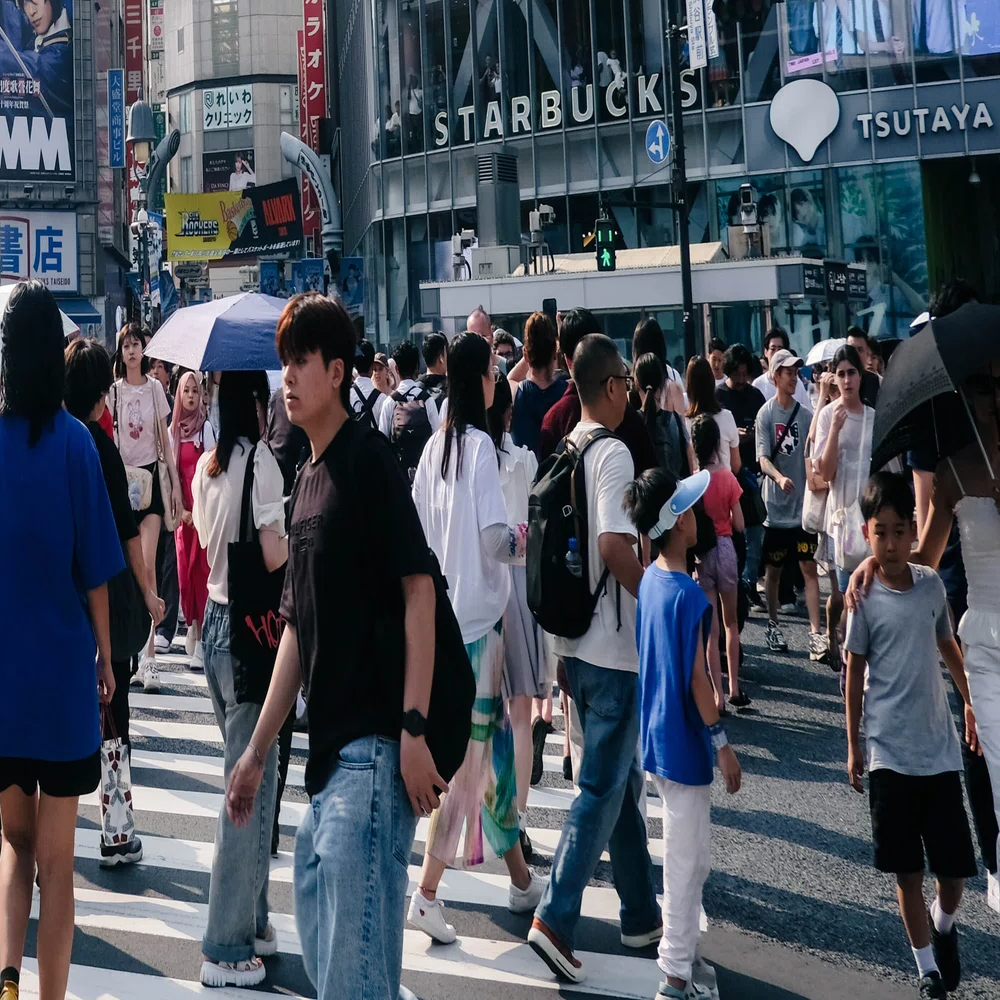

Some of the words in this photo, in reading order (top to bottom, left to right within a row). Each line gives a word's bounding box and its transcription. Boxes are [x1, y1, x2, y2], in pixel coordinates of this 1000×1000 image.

[127, 4, 142, 92] 三千里
[216, 89, 252, 107] れいわ
[434, 70, 701, 147] STARBUCKS
[110, 74, 122, 162] 大盛堂商事ビル
[205, 108, 252, 128] クリニック
[857, 100, 994, 140] TSUTAYA
[175, 211, 219, 237] ROCKERS
[51, 277, 71, 285] TAISEIDO
